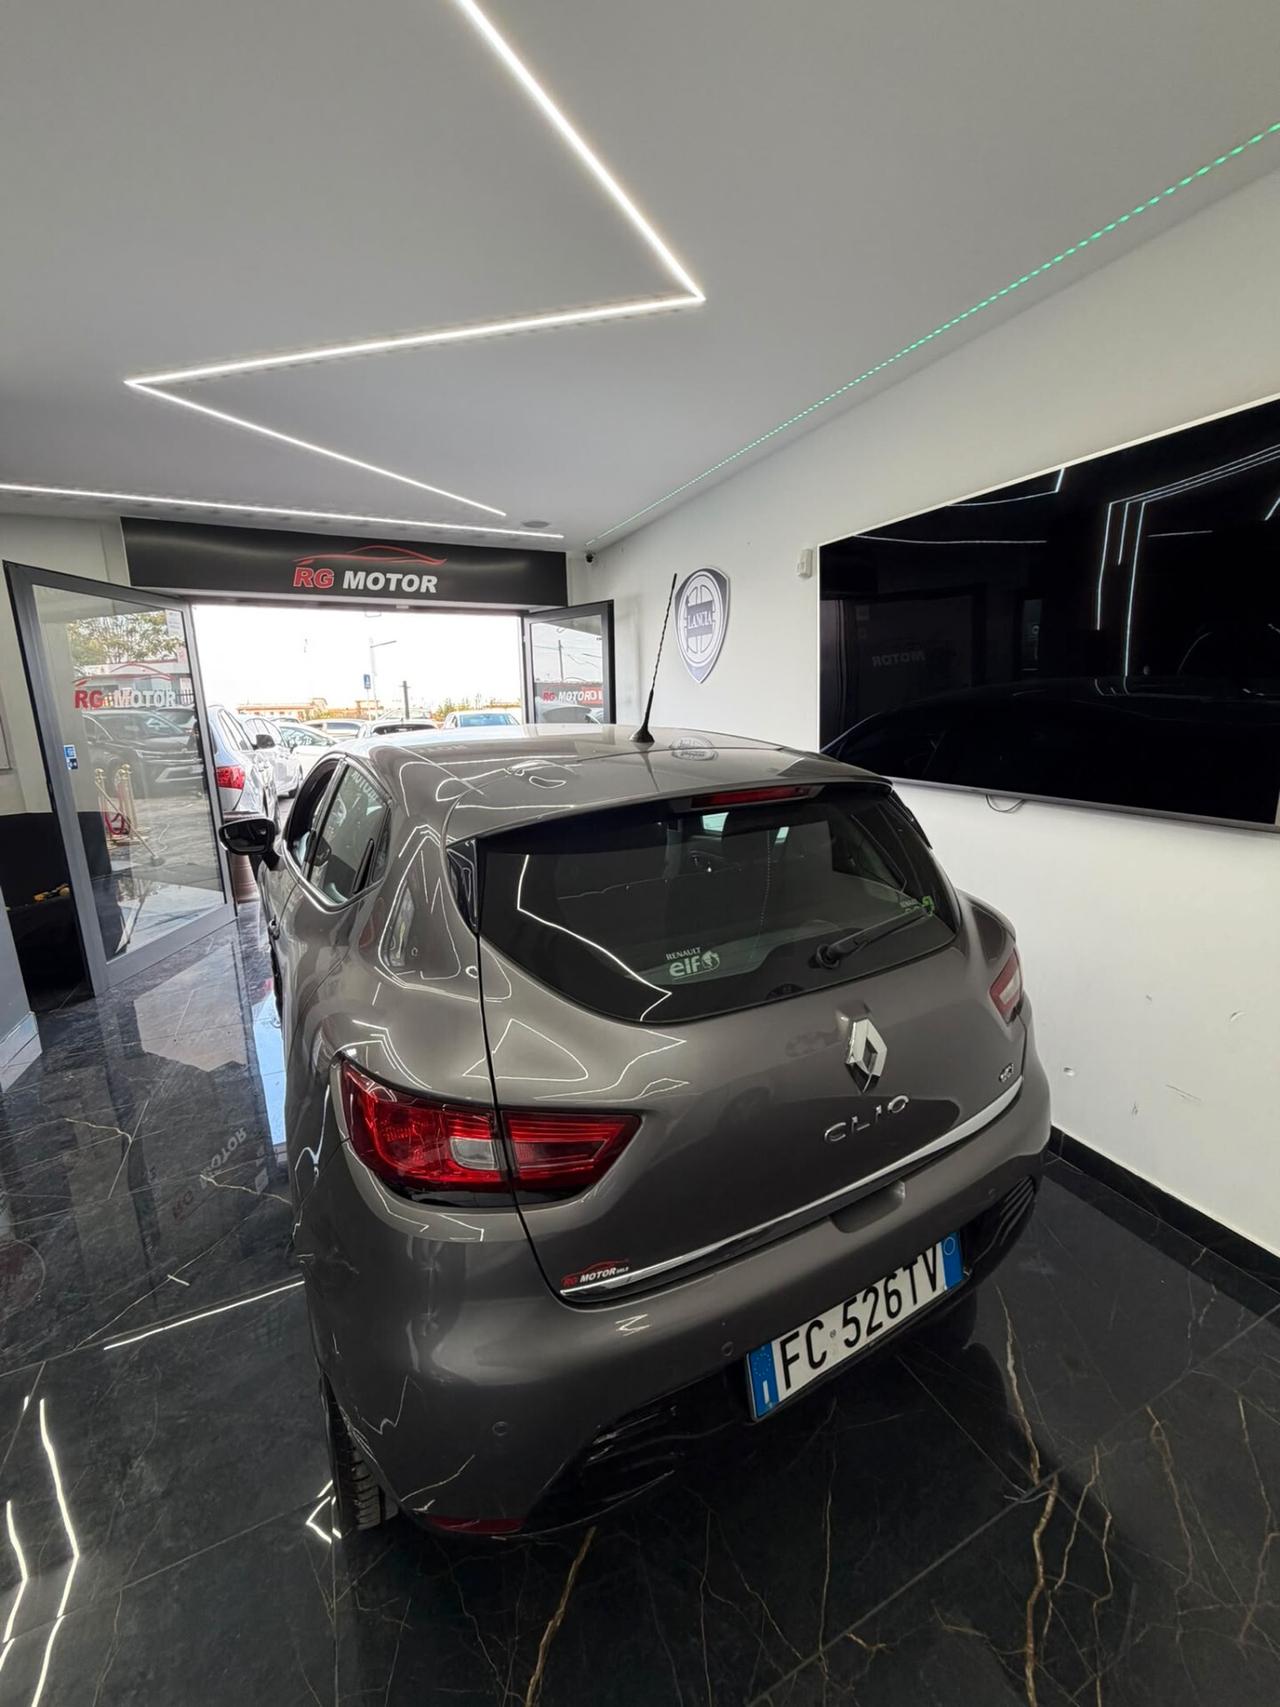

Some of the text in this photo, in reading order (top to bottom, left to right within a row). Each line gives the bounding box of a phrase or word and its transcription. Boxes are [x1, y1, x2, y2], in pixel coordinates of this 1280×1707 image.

[293, 567, 438, 594] RG MOTOR
[687, 610, 713, 629] LANCIA
[74, 688, 177, 709] RG MOTOR
[665, 947, 701, 960] RENAULT
[669, 956, 700, 977] elf
[824, 1095, 909, 1142] CLIO
[580, 1267, 617, 1283] MOTOR
[779, 1246, 938, 1390] FC 526TV
